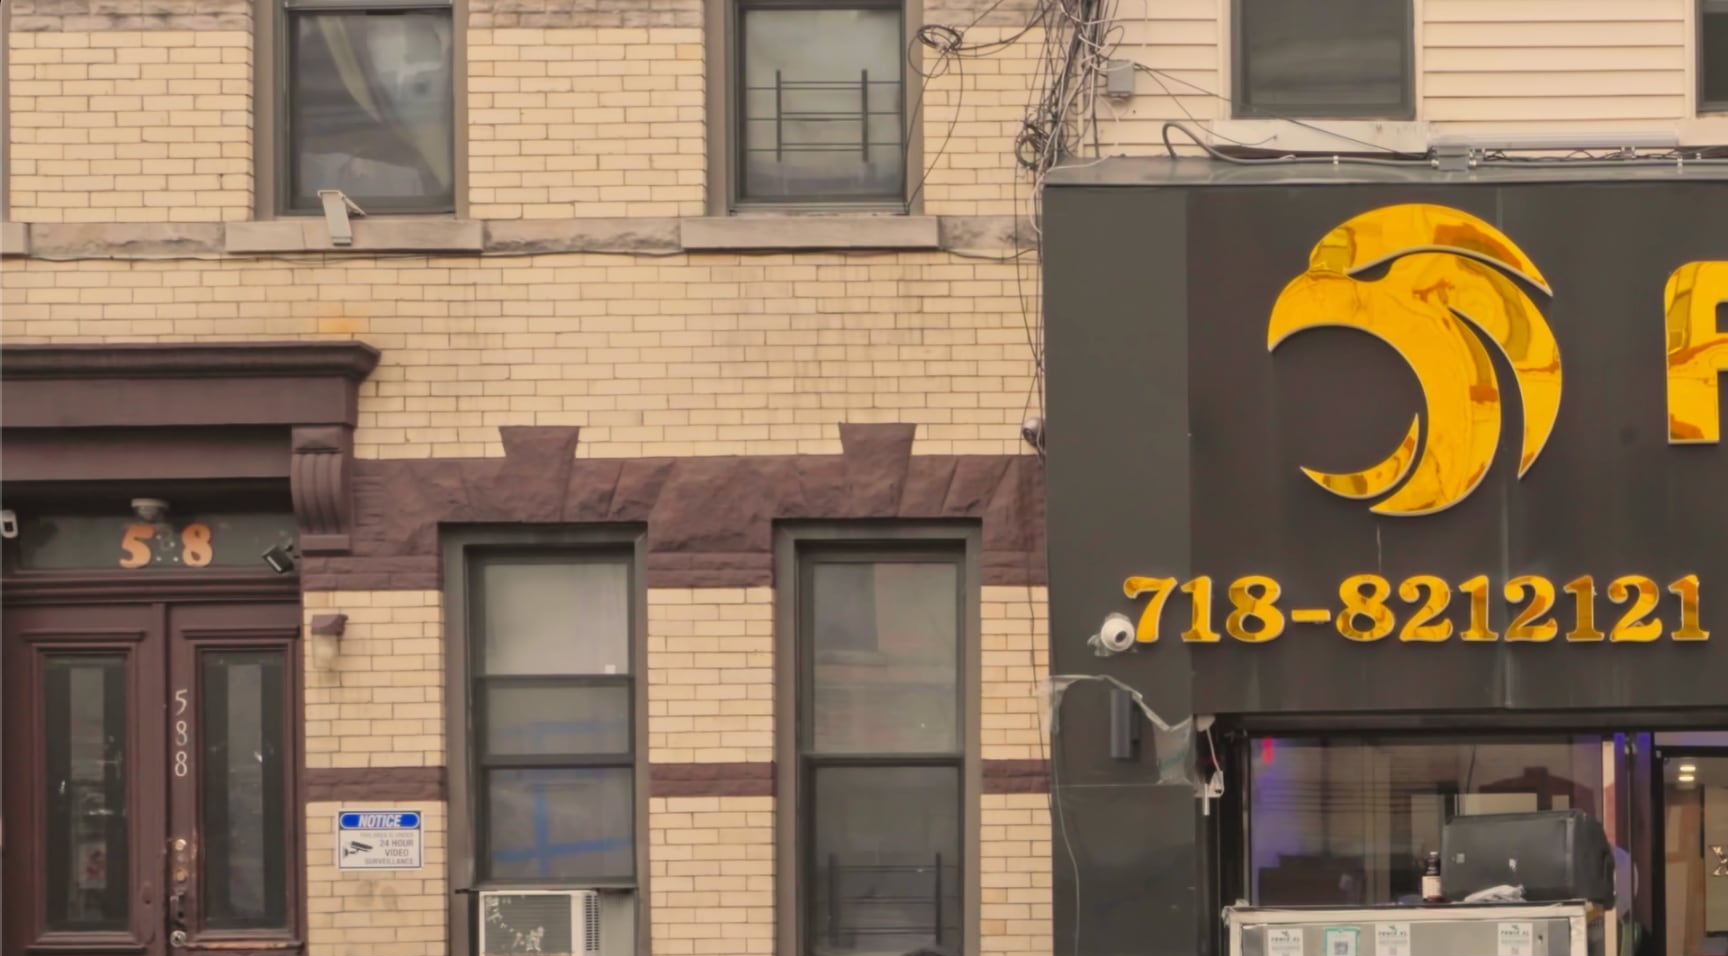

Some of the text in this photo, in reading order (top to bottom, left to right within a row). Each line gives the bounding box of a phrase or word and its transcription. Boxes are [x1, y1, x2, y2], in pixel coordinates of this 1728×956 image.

[1122, 573, 1711, 644] 718-8212121
[174, 688, 188, 777] 588
[358, 813, 403, 829] NOTICE
[379, 839, 414, 847] 24 HOUR
[384, 849, 409, 857] VIDEO
